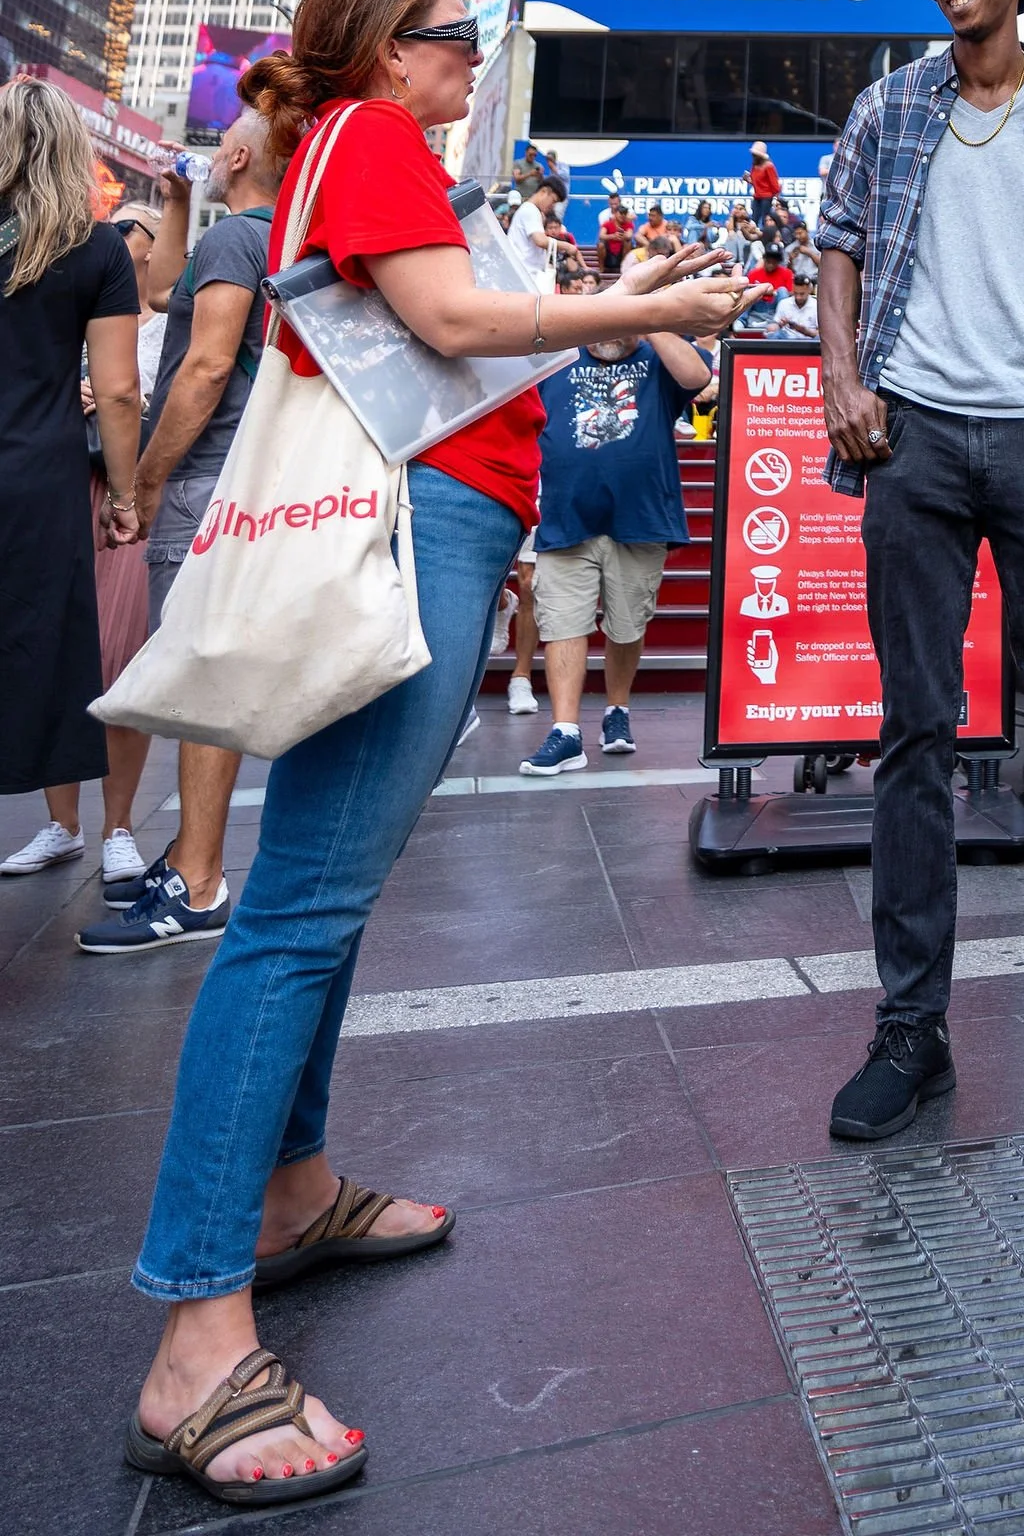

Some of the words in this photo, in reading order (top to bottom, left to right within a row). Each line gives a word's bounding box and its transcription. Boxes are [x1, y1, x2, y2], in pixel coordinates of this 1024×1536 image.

[634, 178, 683, 195] PLAY
[684, 178, 710, 195] TO
[712, 177, 748, 196] WIN
[661, 198, 700, 215] BUS
[566, 360, 649, 380] AMERICAN
[744, 367, 823, 398] Wel
[747, 404, 764, 413] The
[766, 404, 784, 413] Red
[787, 405, 812, 415] Steps
[747, 416, 786, 426] pleasant
[788, 417, 825, 426] experien
[746, 429, 756, 437] to
[758, 428, 773, 437] the
[775, 428, 815, 439] following
[817, 430, 828, 439] gu
[801, 477, 828, 485] Pedes
[222, 486, 378, 542] Intrepid
[800, 514, 824, 522] Kindly
[799, 536, 822, 544] Steps
[799, 570, 825, 579] Always
[826, 569, 849, 577] follow
[850, 569, 864, 577] the
[798, 581, 828, 589] Officers
[798, 592, 813, 600] and
[815, 592, 828, 600] the
[797, 604, 810, 612] the
[812, 604, 830, 613] right
[796, 642, 809, 650] For
[811, 642, 844, 651] dropped
[856, 642, 870, 650] lost
[796, 654, 821, 663] Safety
[823, 653, 848, 661] Officer
[746, 703, 797, 721] Enjoy
[800, 705, 842, 721] your
[845, 701, 884, 717] visit
